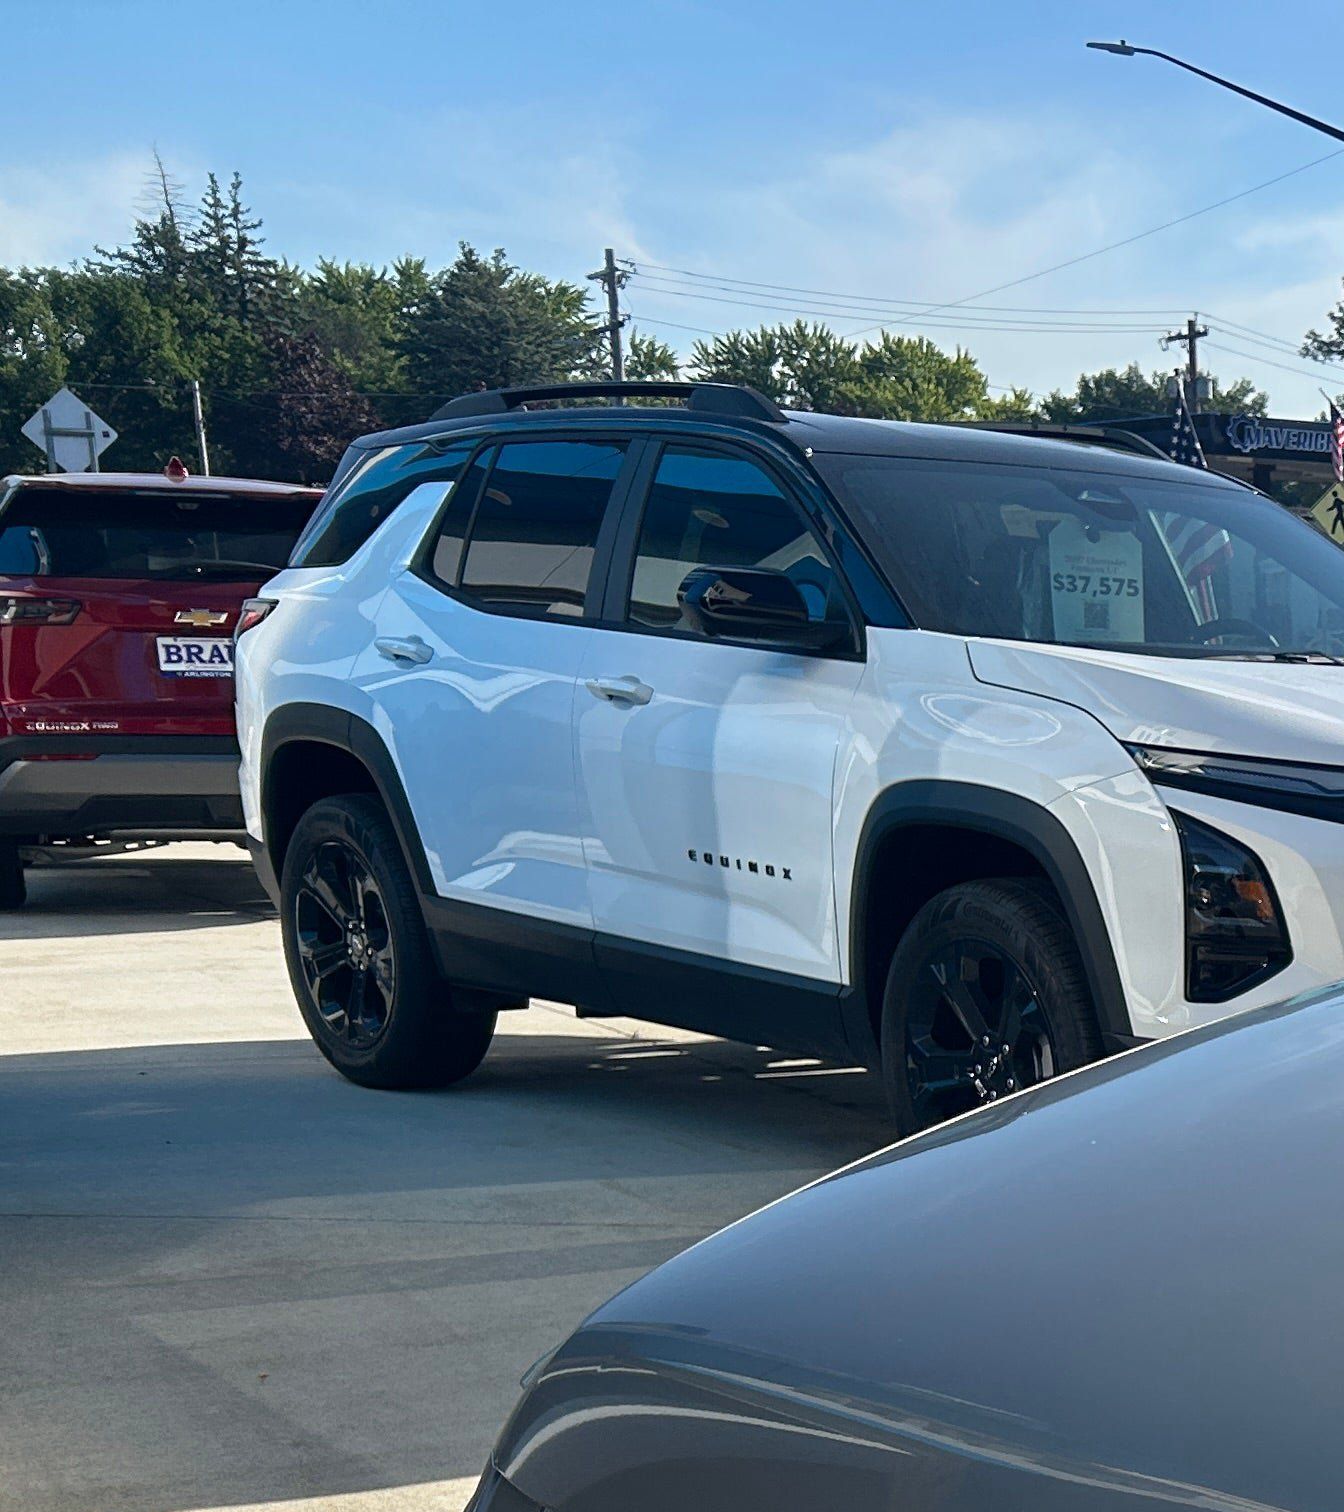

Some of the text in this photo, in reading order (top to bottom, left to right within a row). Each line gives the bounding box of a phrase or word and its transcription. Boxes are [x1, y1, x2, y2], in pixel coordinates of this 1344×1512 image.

[1244, 425, 1336, 453] MAVERIC
[1053, 573, 1140, 597] $37,575
[687, 849, 793, 881] EQUINOX
